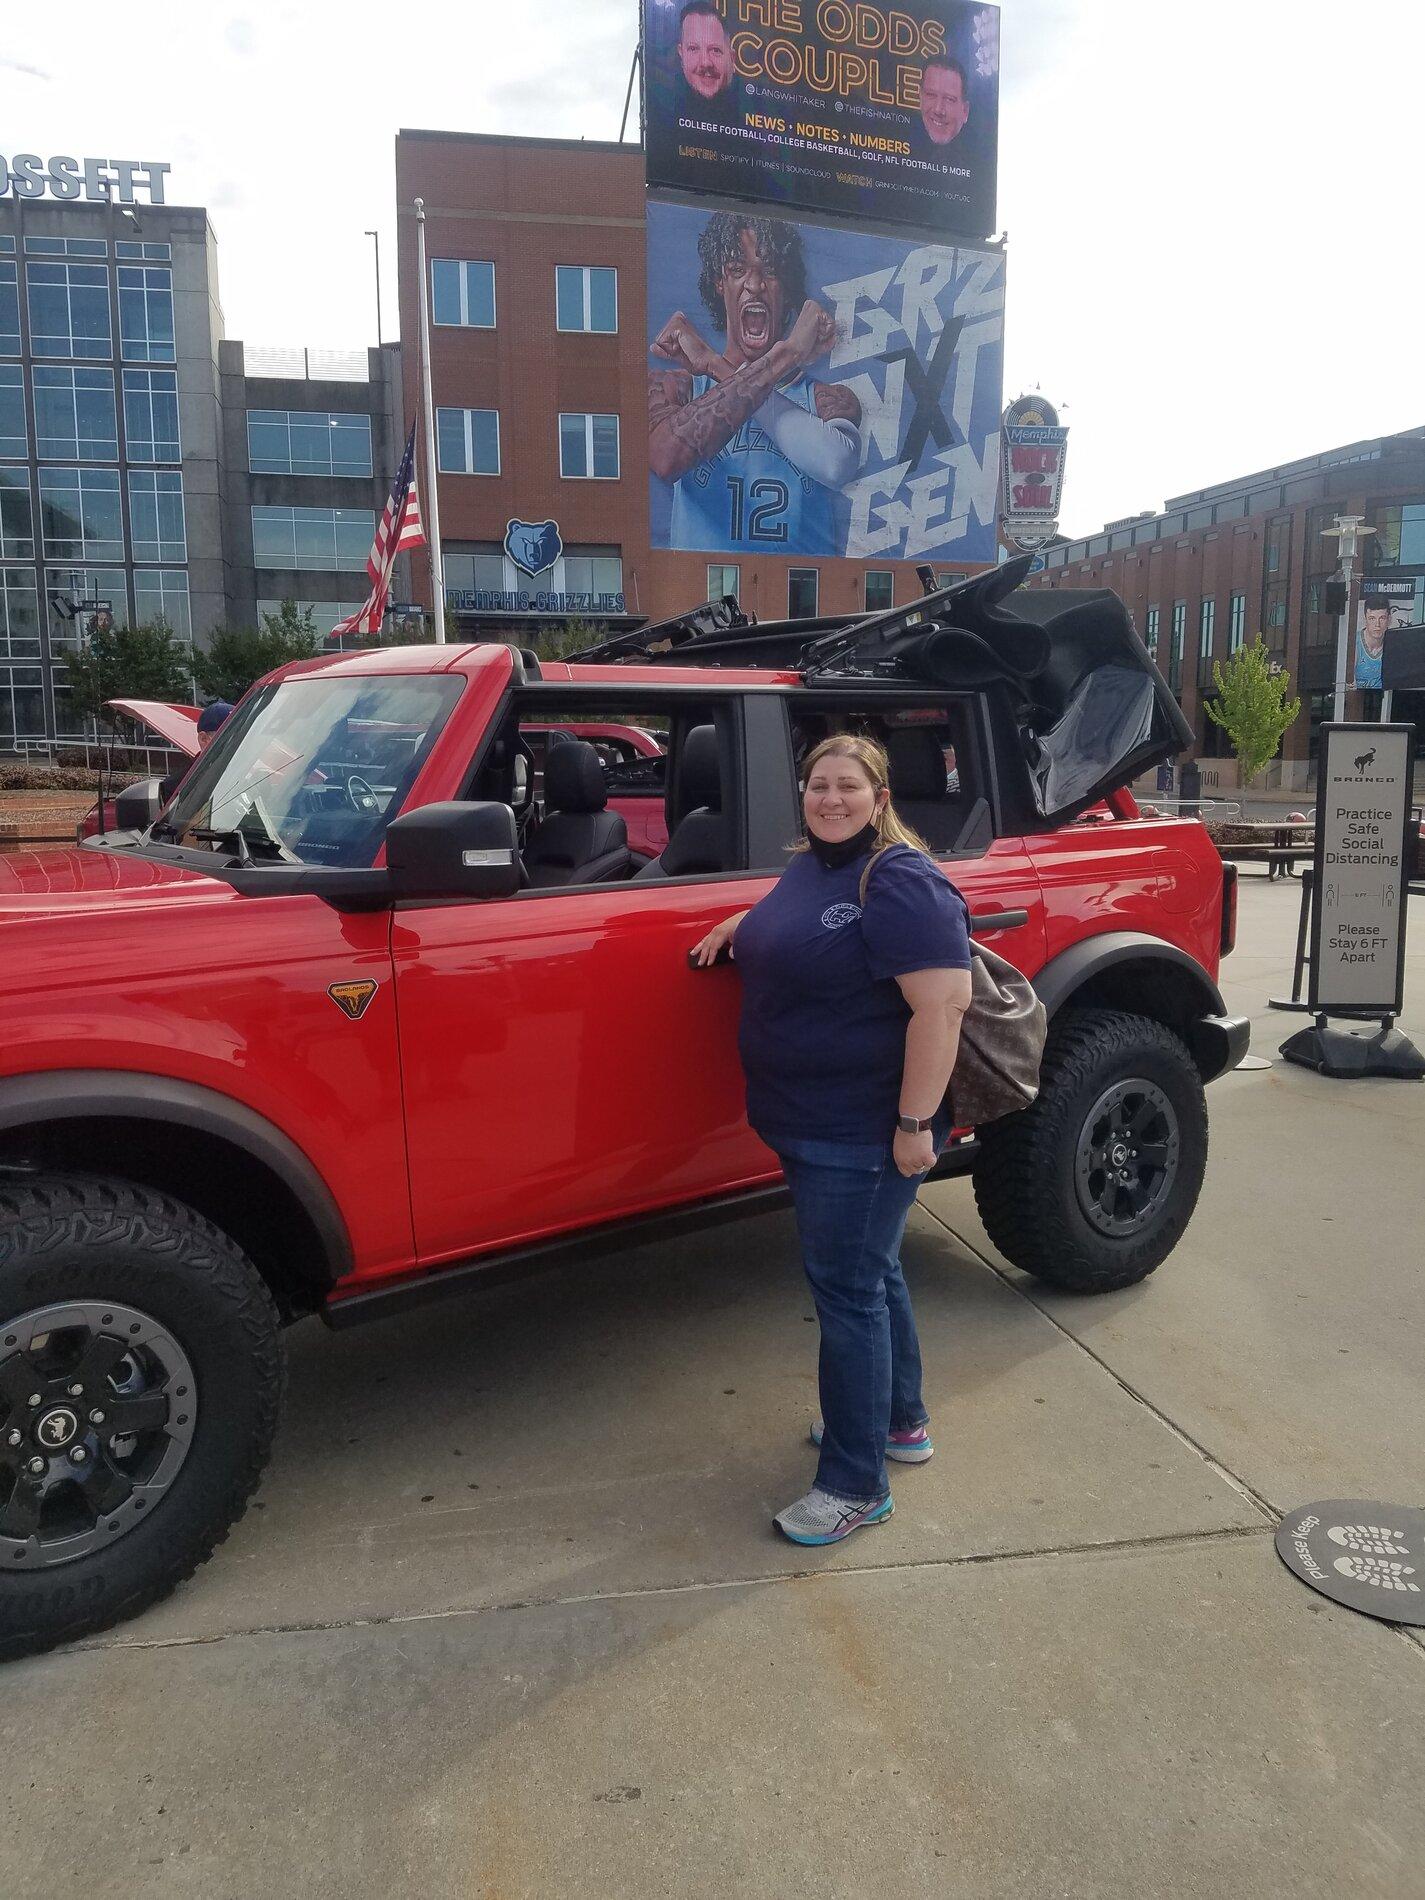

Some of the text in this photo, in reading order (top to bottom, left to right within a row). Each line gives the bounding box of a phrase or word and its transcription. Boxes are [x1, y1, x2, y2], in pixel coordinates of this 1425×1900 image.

[716, 0, 947, 59] HE ODDS
[730, 31, 922, 110] COUPLE
[745, 83, 911, 125] @LANGWHITAKER @THEFISHNATION
[745, 113, 911, 155] NEWS NOTES NUMBERS
[679, 118, 718, 132] COLLEGE
[720, 126, 767, 142] FOOTBALL,
[768, 134, 805, 149] COLLEGE
[806, 141, 861, 160] BASKETBALL,
[862, 151, 884, 164] GOLF,
[886, 155, 900, 165] NFL
[901, 158, 940, 172] FOOTBALL
[949, 166, 971, 178] MORE
[720, 153, 749, 165] SPOTIFY
[786, 164, 831, 178] SOUNDCLOUD
[1009, 428, 1065, 444] Memphis
[842, 431, 1000, 559] GEN
[727, 475, 789, 542] 12
[445, 590, 626, 612] MEMPHIS GRIZZLIES
[1336, 808, 1392, 819] Practice
[1348, 823, 1379, 835] Safe
[1341, 838, 1384, 849] Social
[1325, 853, 1398, 867] Distancing
[1338, 924, 1380, 935] Please
[1329, 938, 1388, 950] Stay 6 FT
[1340, 952, 1375, 964] Apart
[1291, 1515, 1330, 1580] Please Keep
